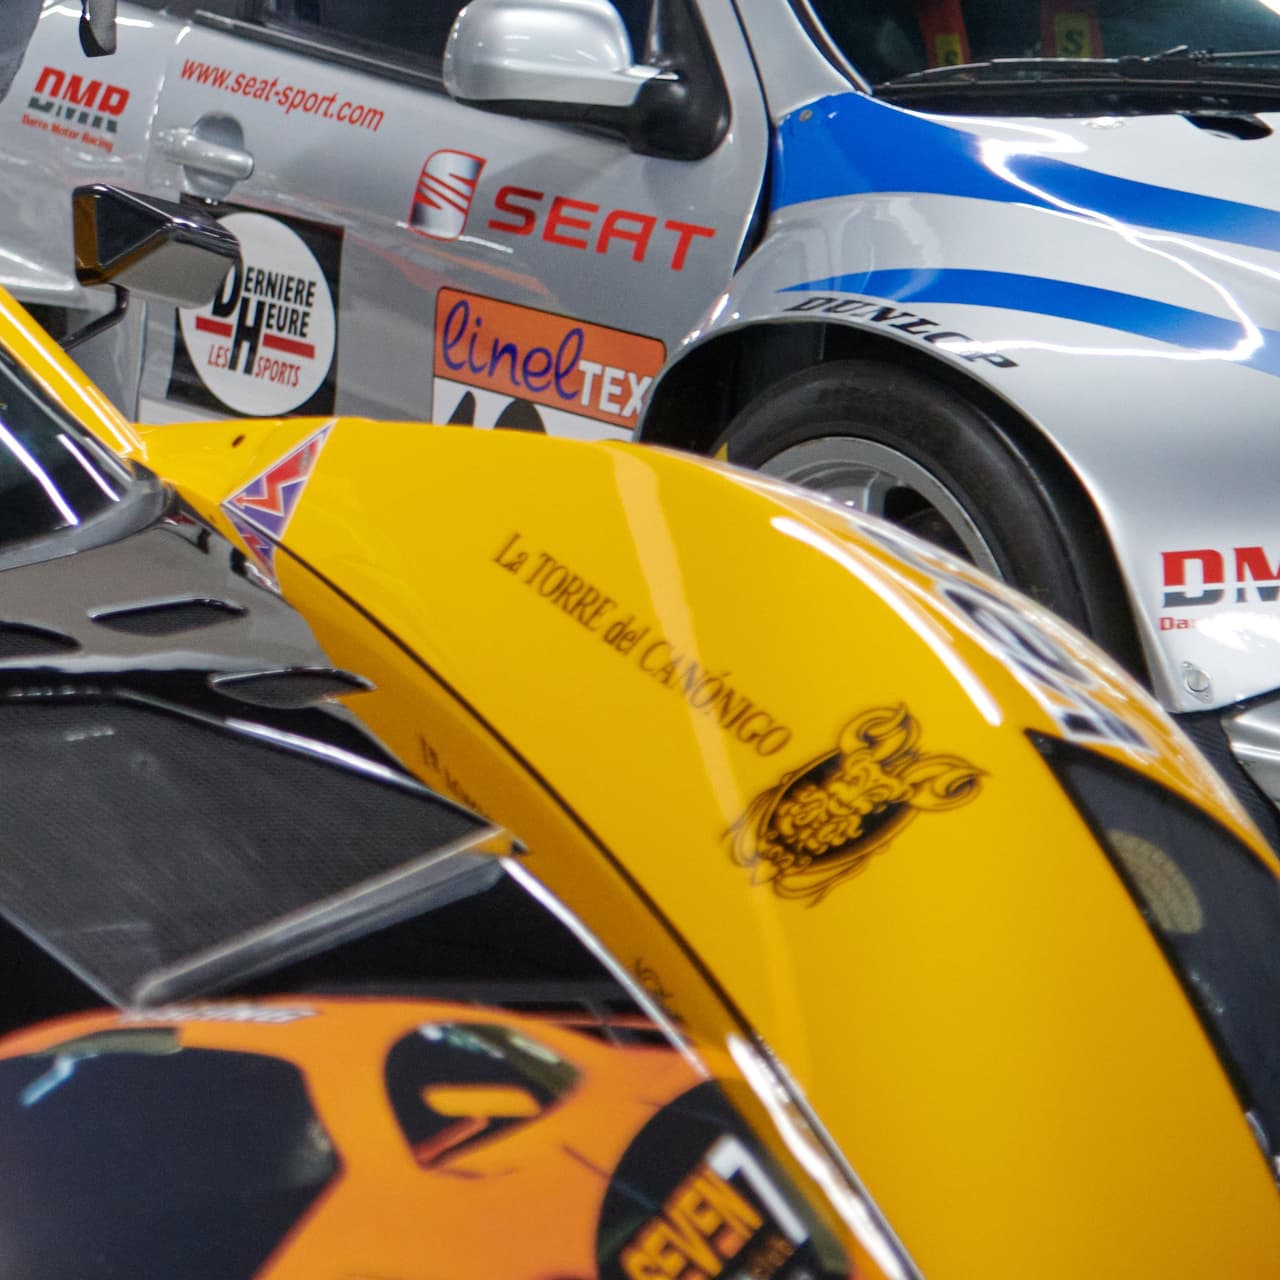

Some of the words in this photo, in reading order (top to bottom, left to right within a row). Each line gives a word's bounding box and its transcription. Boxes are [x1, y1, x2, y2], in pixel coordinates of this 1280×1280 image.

[180, 58, 385, 134] www.seat-sport.com
[488, 185, 716, 271] SEAT
[208, 343, 230, 369] LES
[254, 355, 301, 388] SPORTS
[784, 296, 1020, 368] DUNLOP
[492, 532, 528, 575] La
[524, 552, 619, 632] TORRE
[602, 616, 651, 657] del
[639, 640, 793, 757] CANÓNIGO
